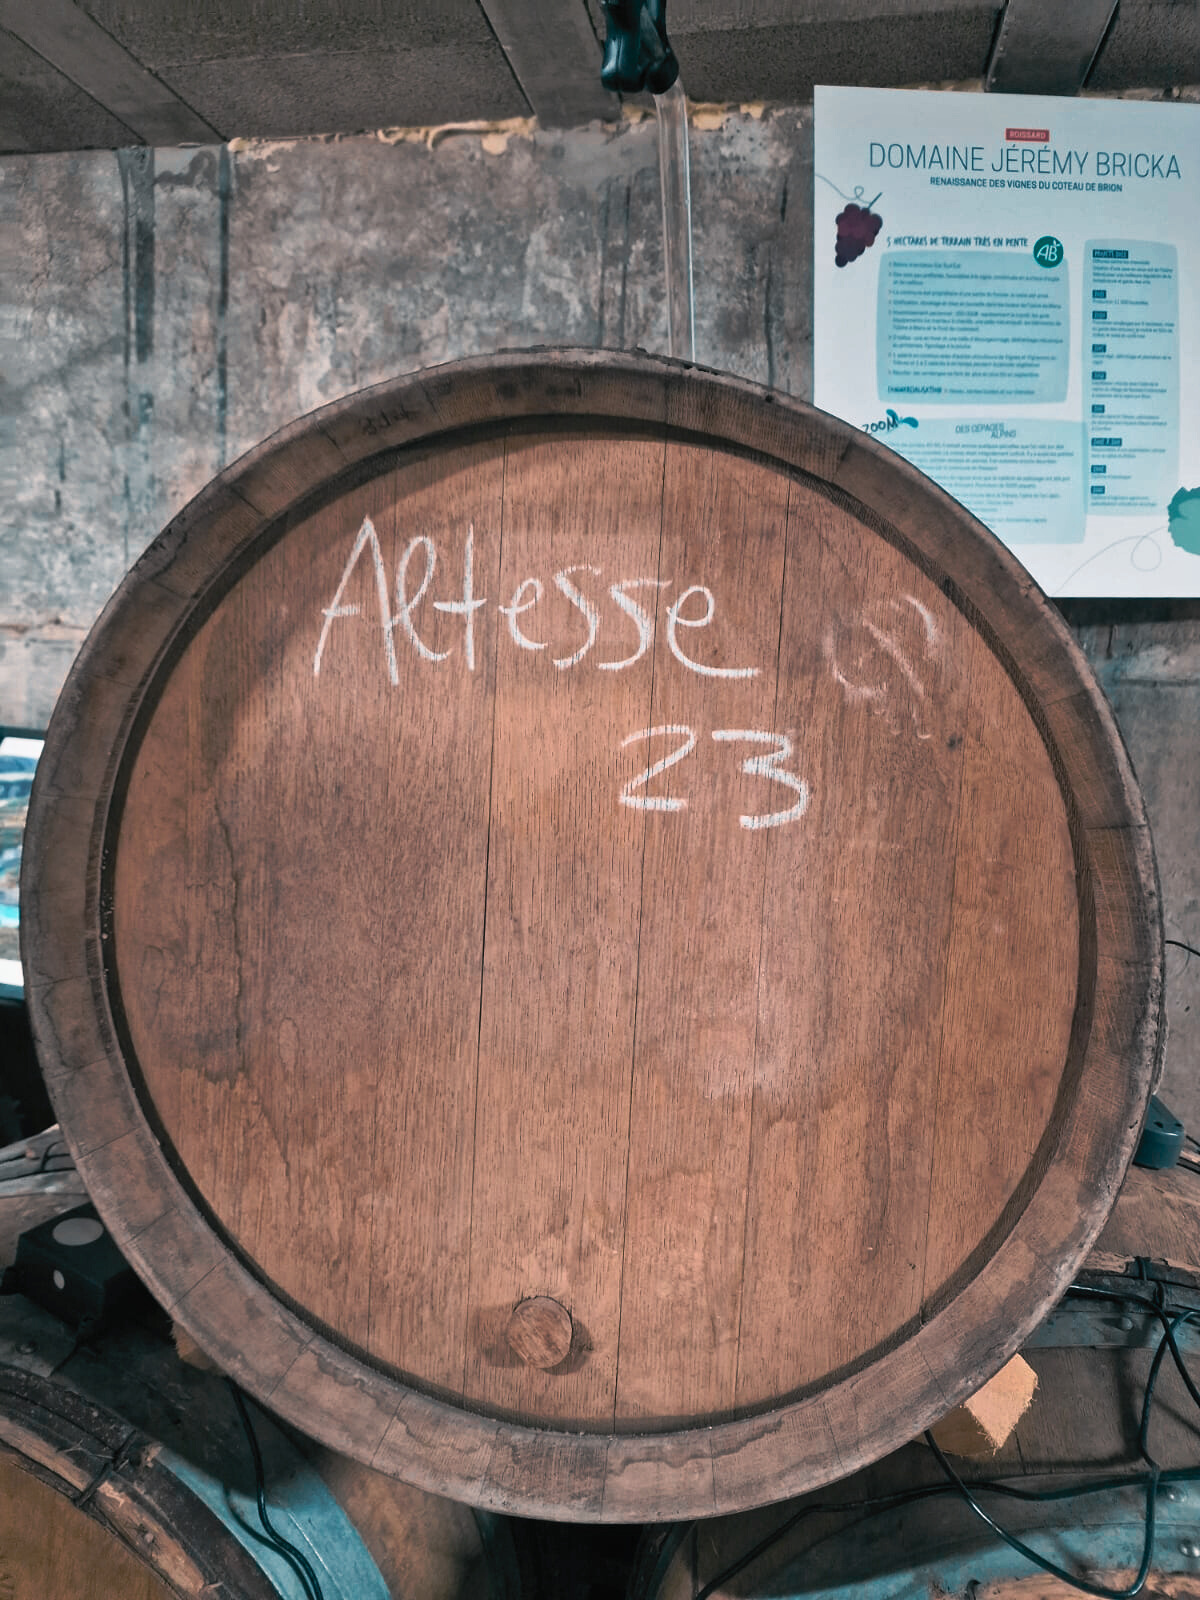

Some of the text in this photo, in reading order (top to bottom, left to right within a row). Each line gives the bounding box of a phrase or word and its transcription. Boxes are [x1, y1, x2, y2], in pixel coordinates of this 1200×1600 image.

[869, 142, 1182, 180] DOMAINE JÉRÉMY BRICKA
[930, 176, 1123, 193] RENAISSANCE DES VIGNES DU COTEAU DE BRION
[886, 237, 891, 247] 5
[893, 236, 928, 247] HECTARES
[930, 237, 938, 247] DE
[942, 236, 972, 247] TERRAIN
[993, 238, 1003, 247] EN
[1005, 237, 1028, 248] PENTE
[1036, 243, 1058, 262] AB
[312, 514, 761, 687] Altesse
[618, 723, 811, 831] 23
